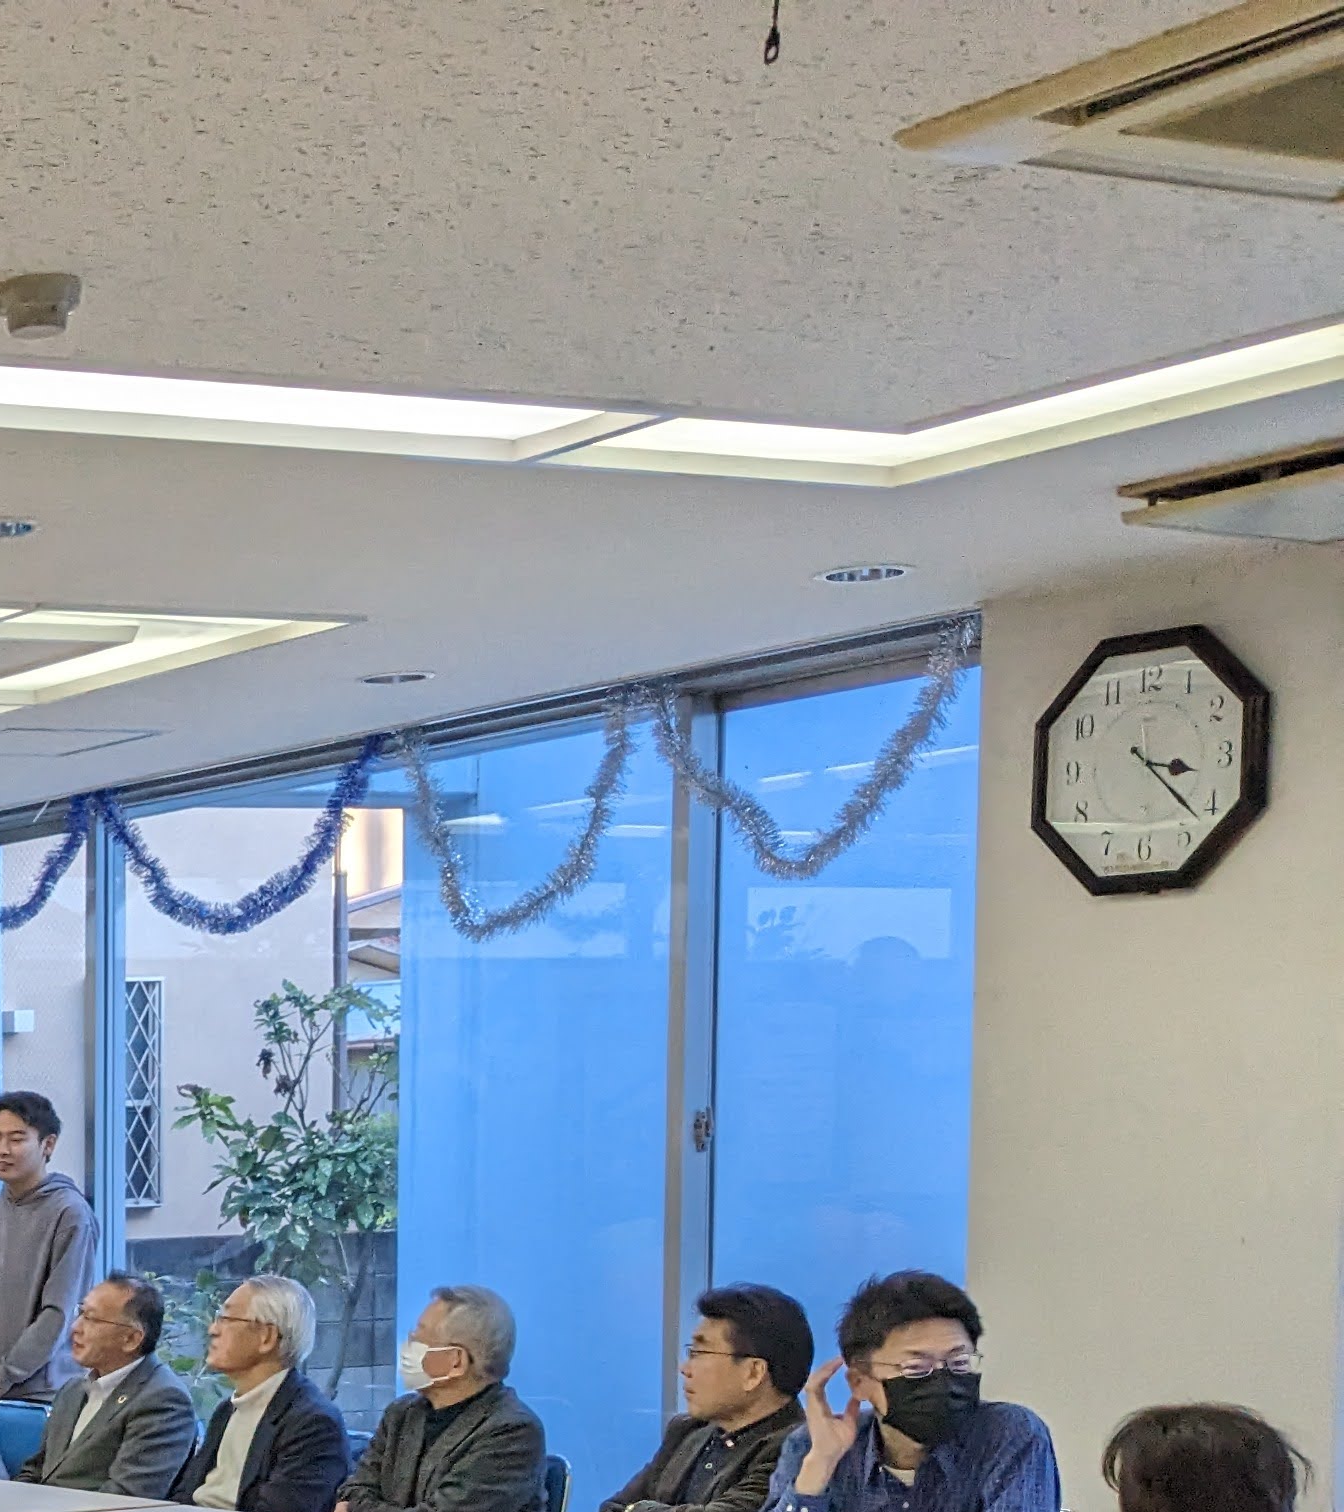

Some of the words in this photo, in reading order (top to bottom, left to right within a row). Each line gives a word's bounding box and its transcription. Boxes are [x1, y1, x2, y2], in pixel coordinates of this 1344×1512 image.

[1104, 680, 1121, 705] 11
[1140, 667, 1163, 693] 12
[1184, 670, 1192, 694] 1
[1209, 695, 1224, 722] 2
[1074, 714, 1095, 741] 10
[1217, 740, 1233, 768] 3
[1066, 761, 1080, 785] 9
[1074, 800, 1088, 823] 8
[1204, 788, 1218, 815] 4
[1101, 831, 1114, 855] 7
[1137, 834, 1152, 860] 6
[1177, 822, 1191, 848] 5
